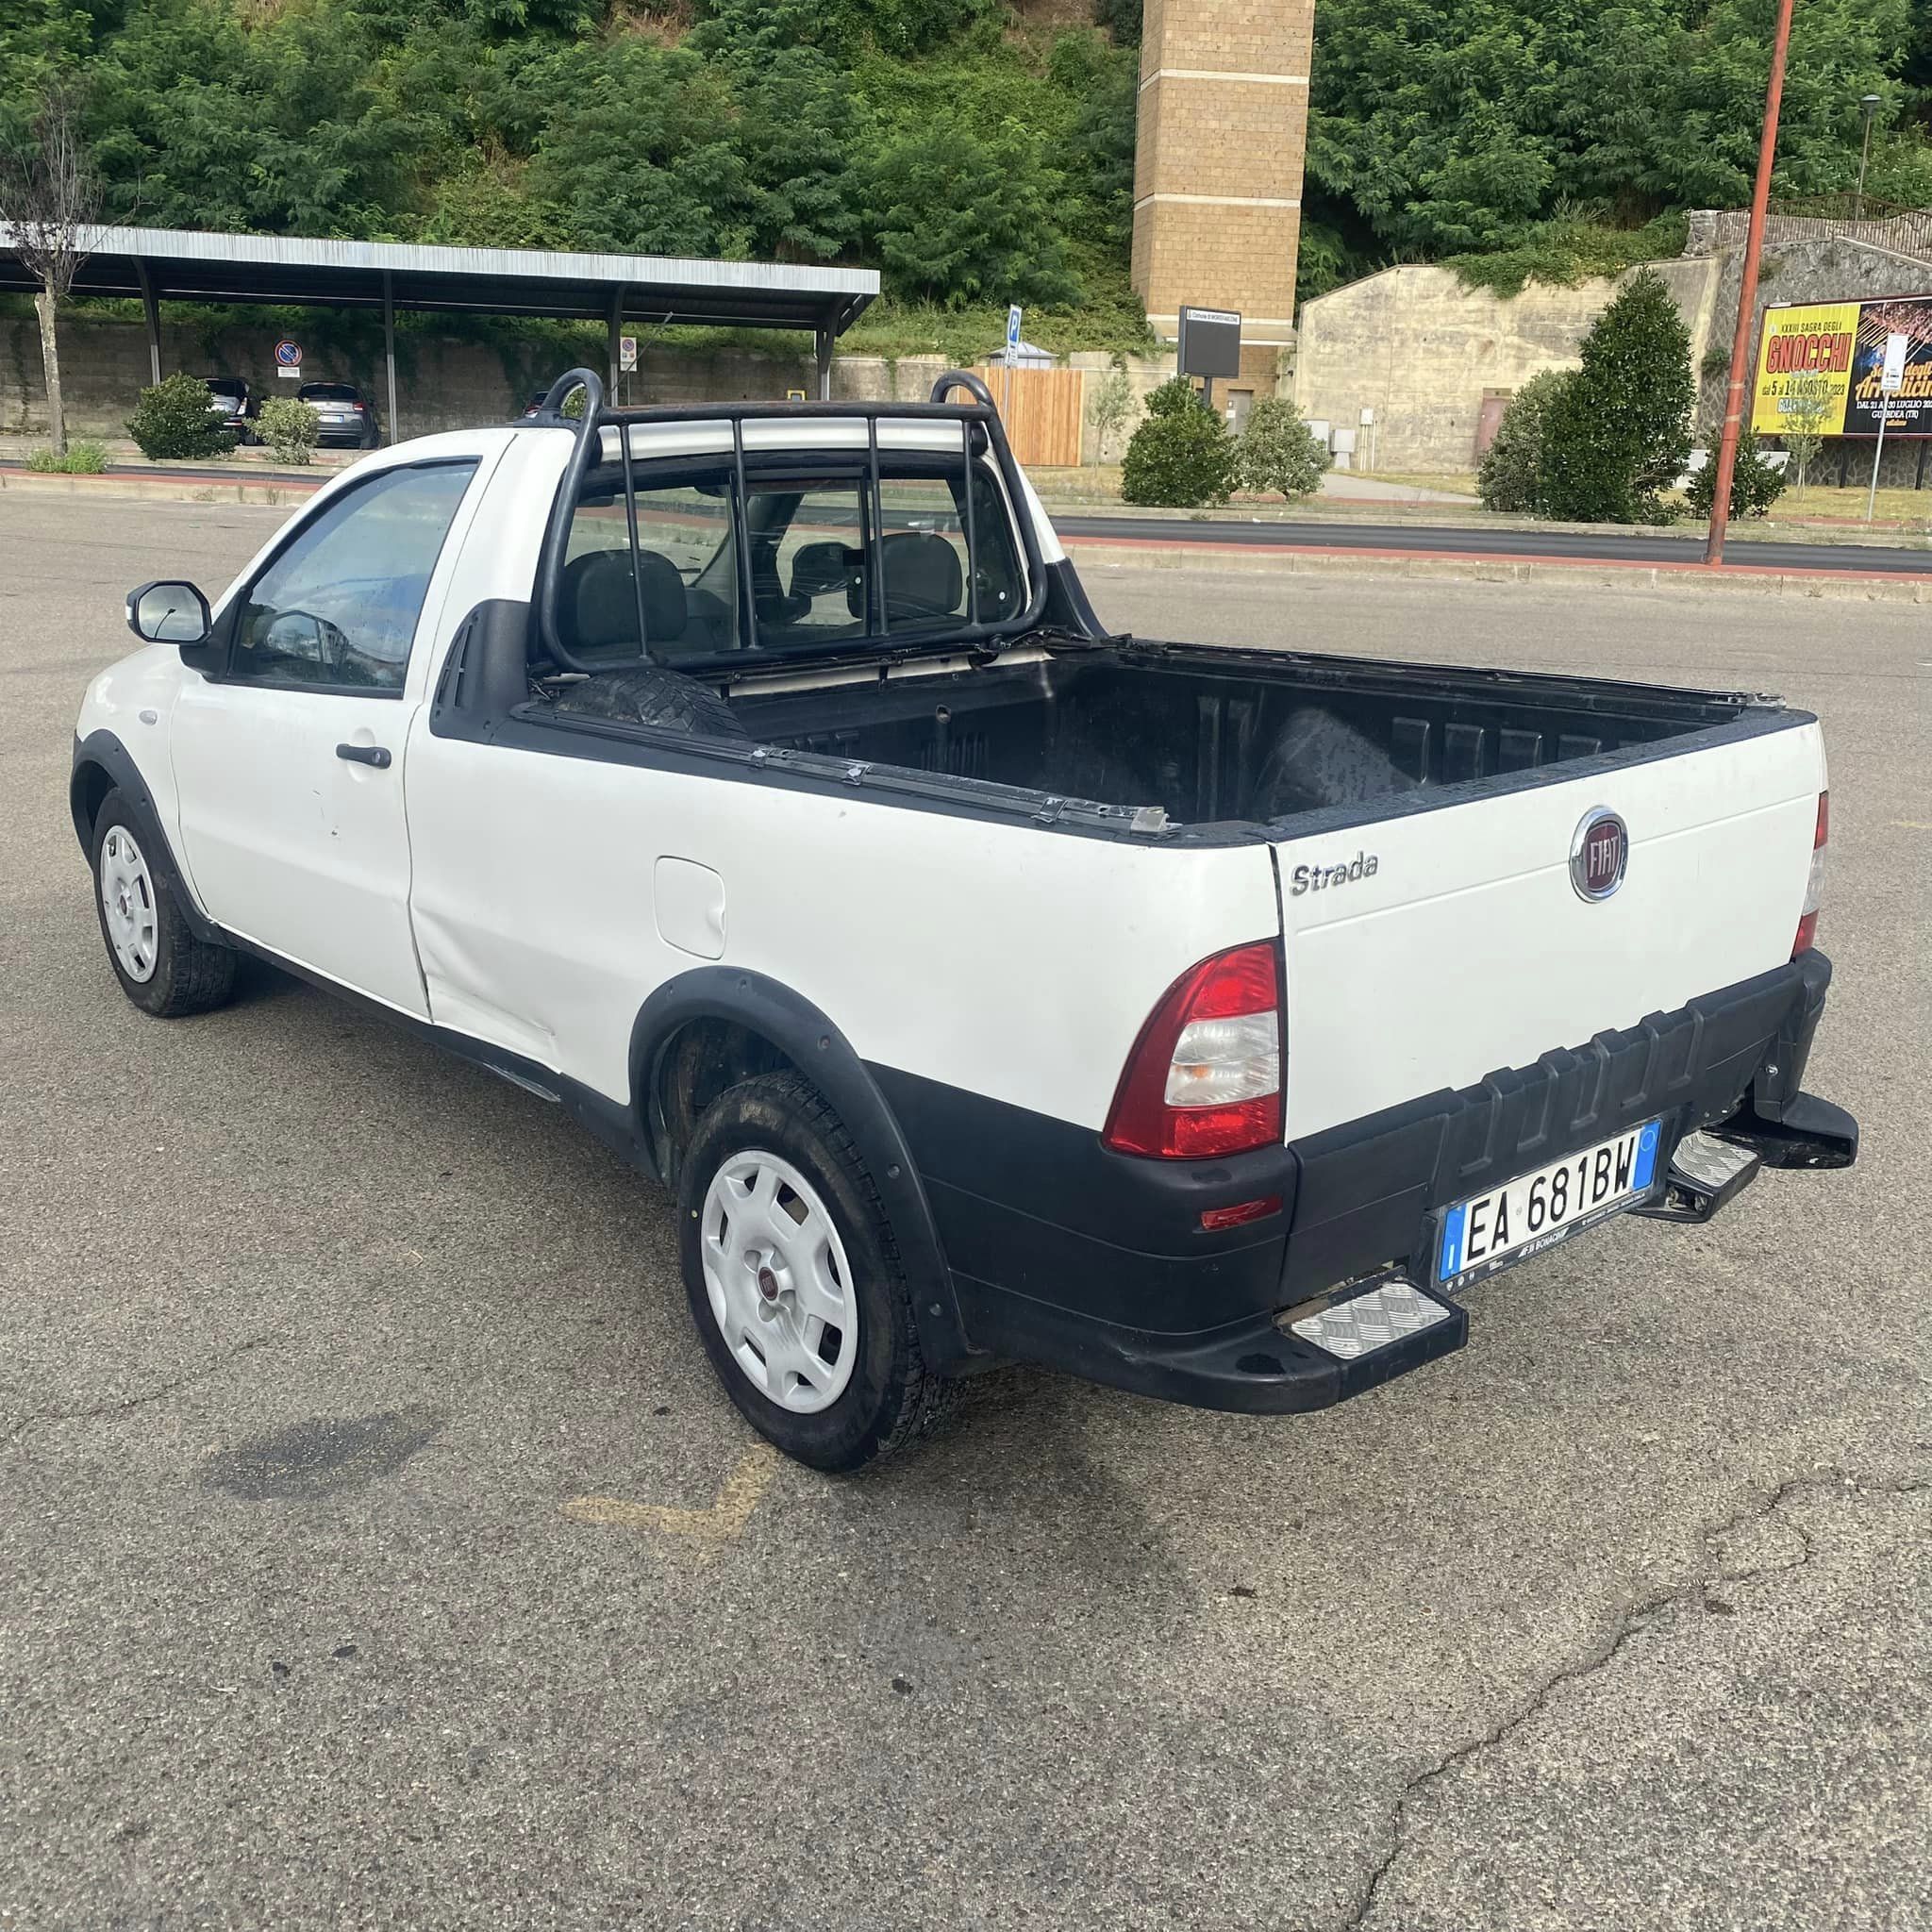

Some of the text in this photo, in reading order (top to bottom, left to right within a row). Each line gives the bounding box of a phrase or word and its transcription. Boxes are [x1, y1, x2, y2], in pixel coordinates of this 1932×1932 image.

[1801, 322, 1822, 332] SAGRA
[1823, 322, 1841, 332] DEGLI
[1766, 332, 1853, 374] GNOCCHI
[1772, 380, 1777, 395] 5
[1872, 409, 1905, 418] GURDEA
[1896, 400, 1923, 408] LUGLIO
[1590, 836, 1619, 878] FIAT
[1290, 850, 1378, 896] Strada
[1467, 1191, 1509, 1262] EA
[1527, 1136, 1636, 1232] 681BW
